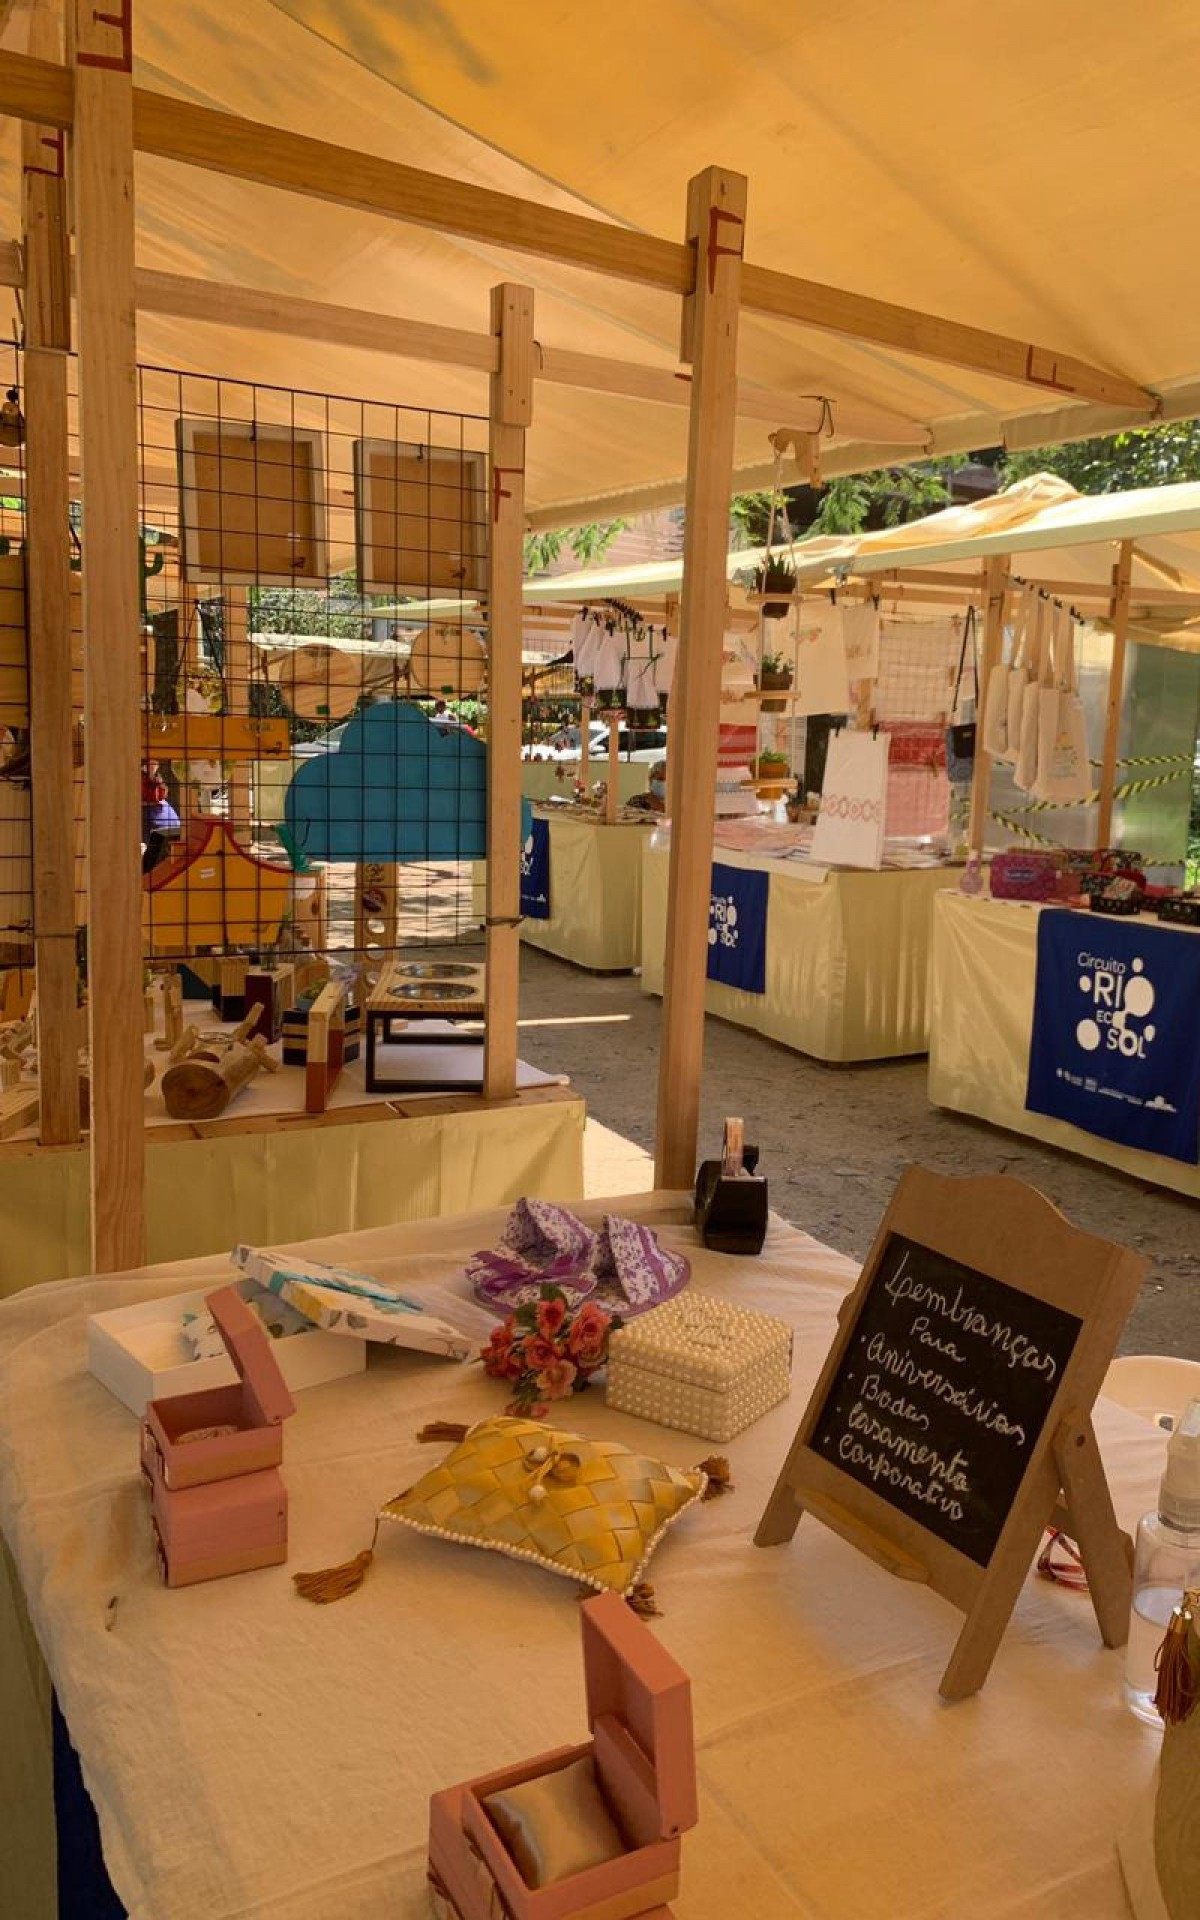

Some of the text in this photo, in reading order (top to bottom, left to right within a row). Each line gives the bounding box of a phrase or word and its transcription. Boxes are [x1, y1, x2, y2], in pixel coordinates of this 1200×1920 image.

[1077, 951, 1126, 975] Circuito
[1106, 1028, 1147, 1059] SOL
[909, 1316, 967, 1363] Para
[860, 1374, 930, 1431] Bodas
